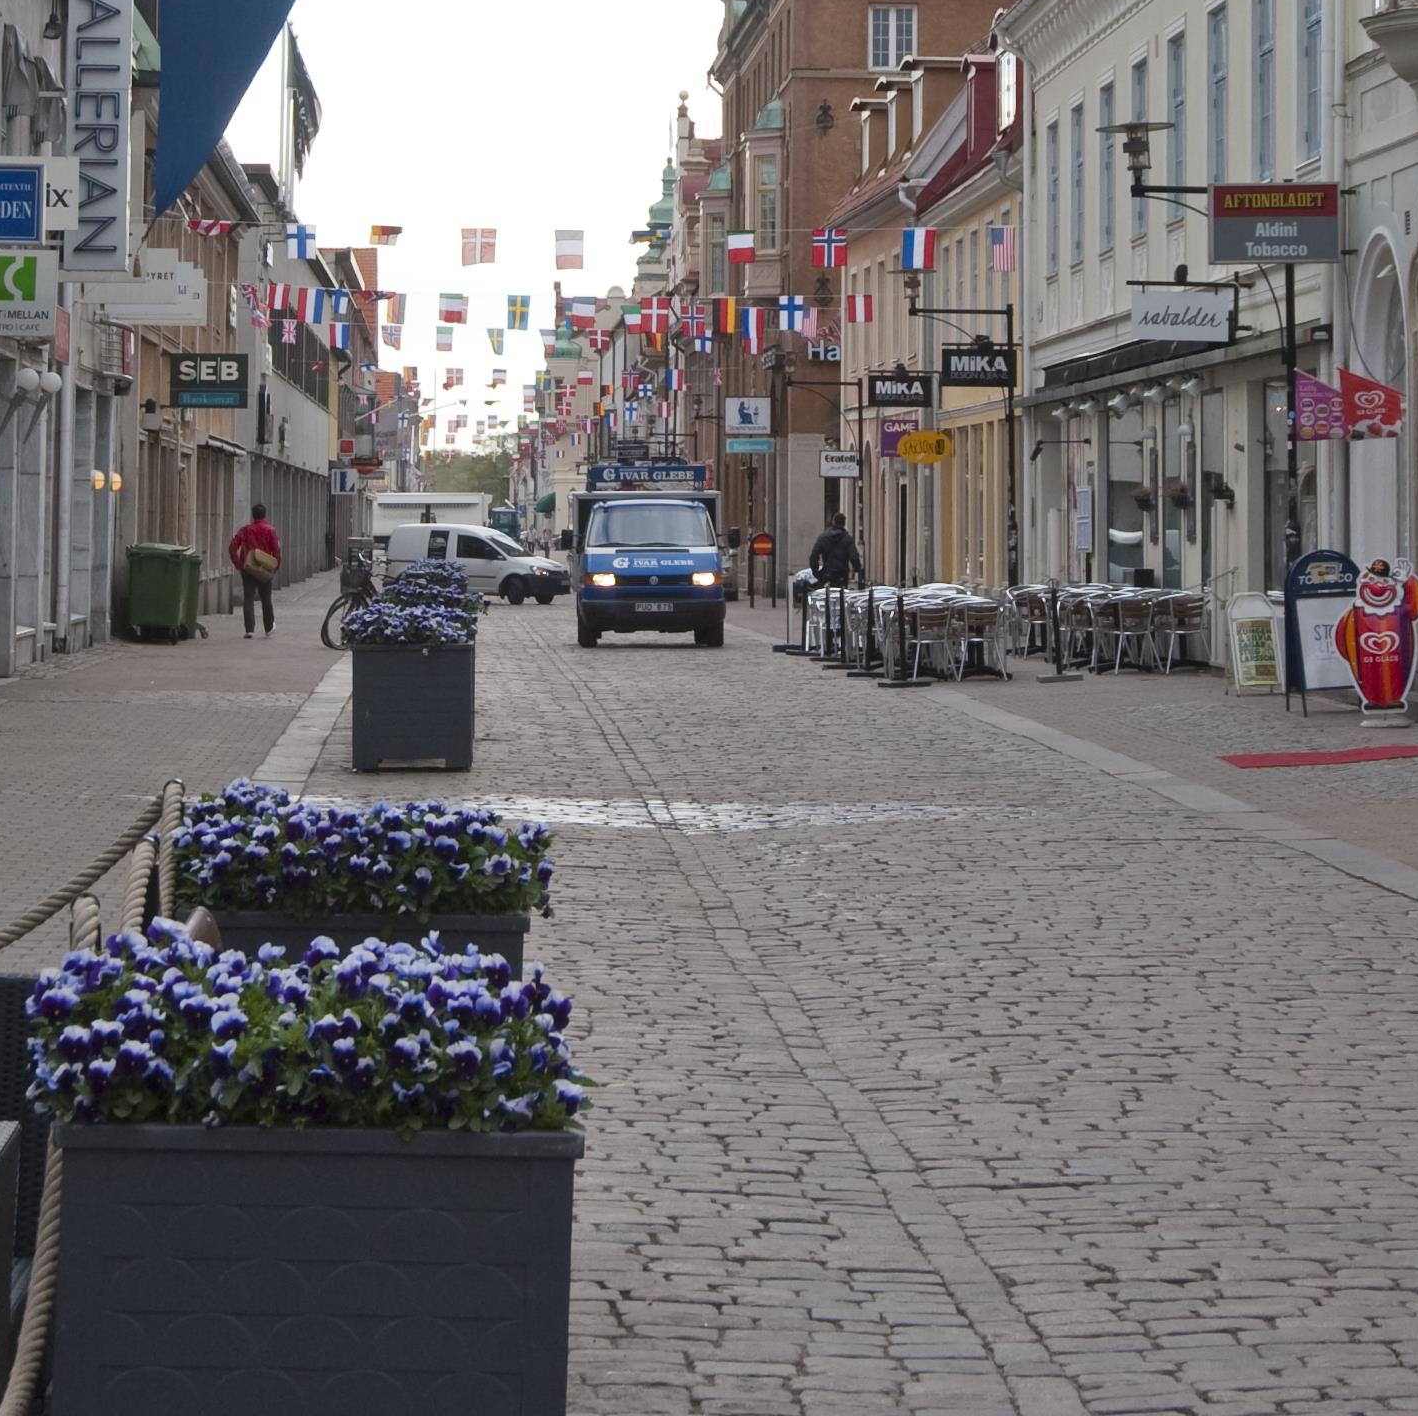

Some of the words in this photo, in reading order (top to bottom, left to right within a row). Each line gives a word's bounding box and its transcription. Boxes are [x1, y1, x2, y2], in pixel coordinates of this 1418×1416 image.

[45, 182, 70, 208] ix
[1223, 192, 1325, 209] AFTONBLADET
[1255, 221, 1298, 238] Aldini
[1245, 242, 1308, 257] Tobacco
[1138, 304, 1221, 328] rabalder
[807, 339, 842, 361] Ha
[178, 360, 240, 381] SEB
[950, 355, 1008, 371] MiKA
[875, 380, 924, 395] MiKA
[883, 422, 917, 433] GAME
[619, 471, 649, 480] IVAR
[652, 470, 695, 480] GLEBE
[633, 559, 658, 567] IVAR
